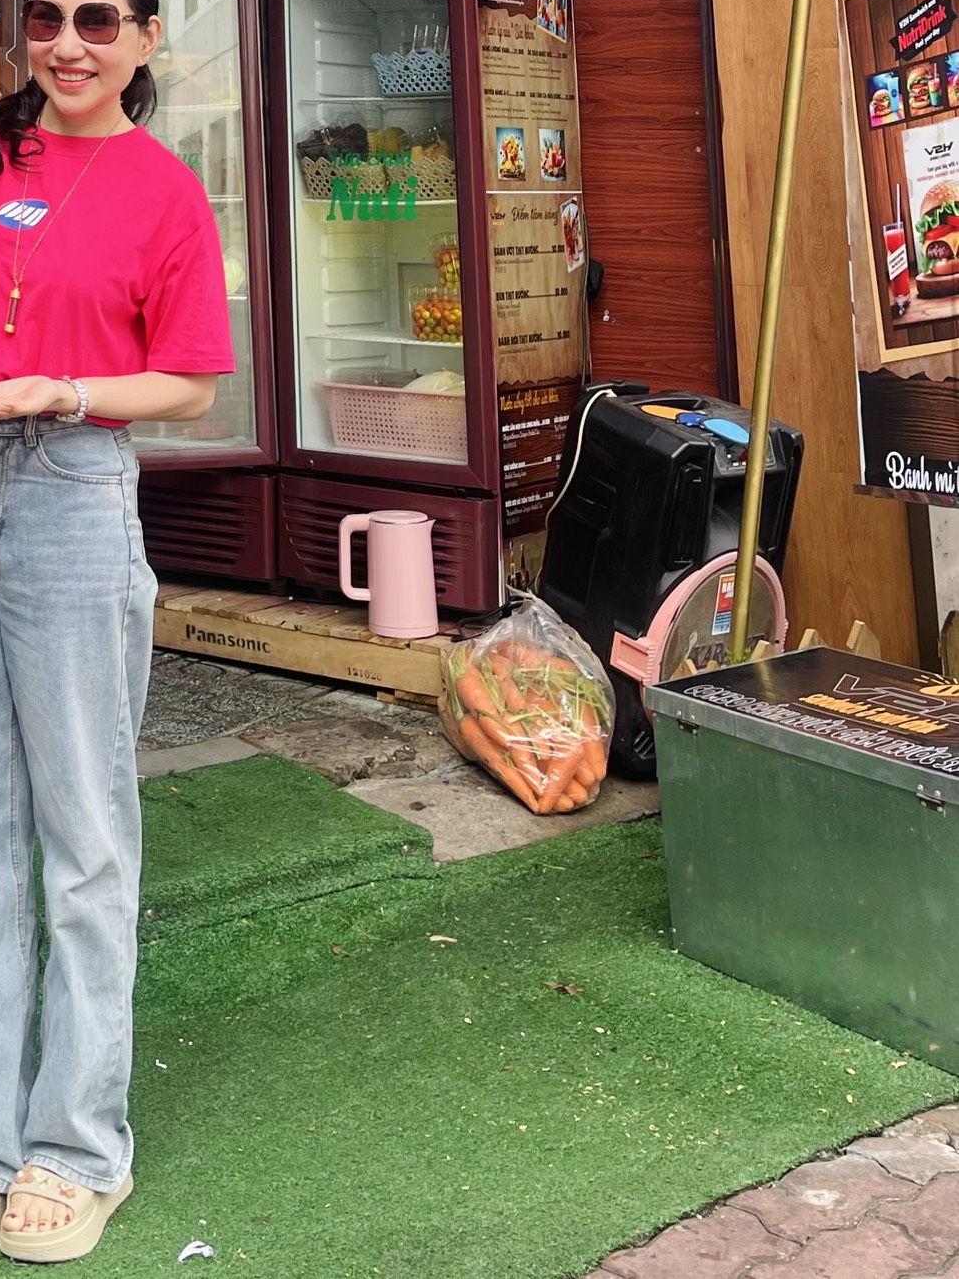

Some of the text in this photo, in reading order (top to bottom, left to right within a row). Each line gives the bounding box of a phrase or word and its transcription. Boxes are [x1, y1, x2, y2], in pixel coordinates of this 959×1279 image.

[898, 4, 947, 53] NutriDrink
[925, 142, 953, 156] V2H
[326, 176, 418, 222] Nuti
[885, 451, 955, 494] Bánh mì
[185, 623, 272, 655] Panasonic
